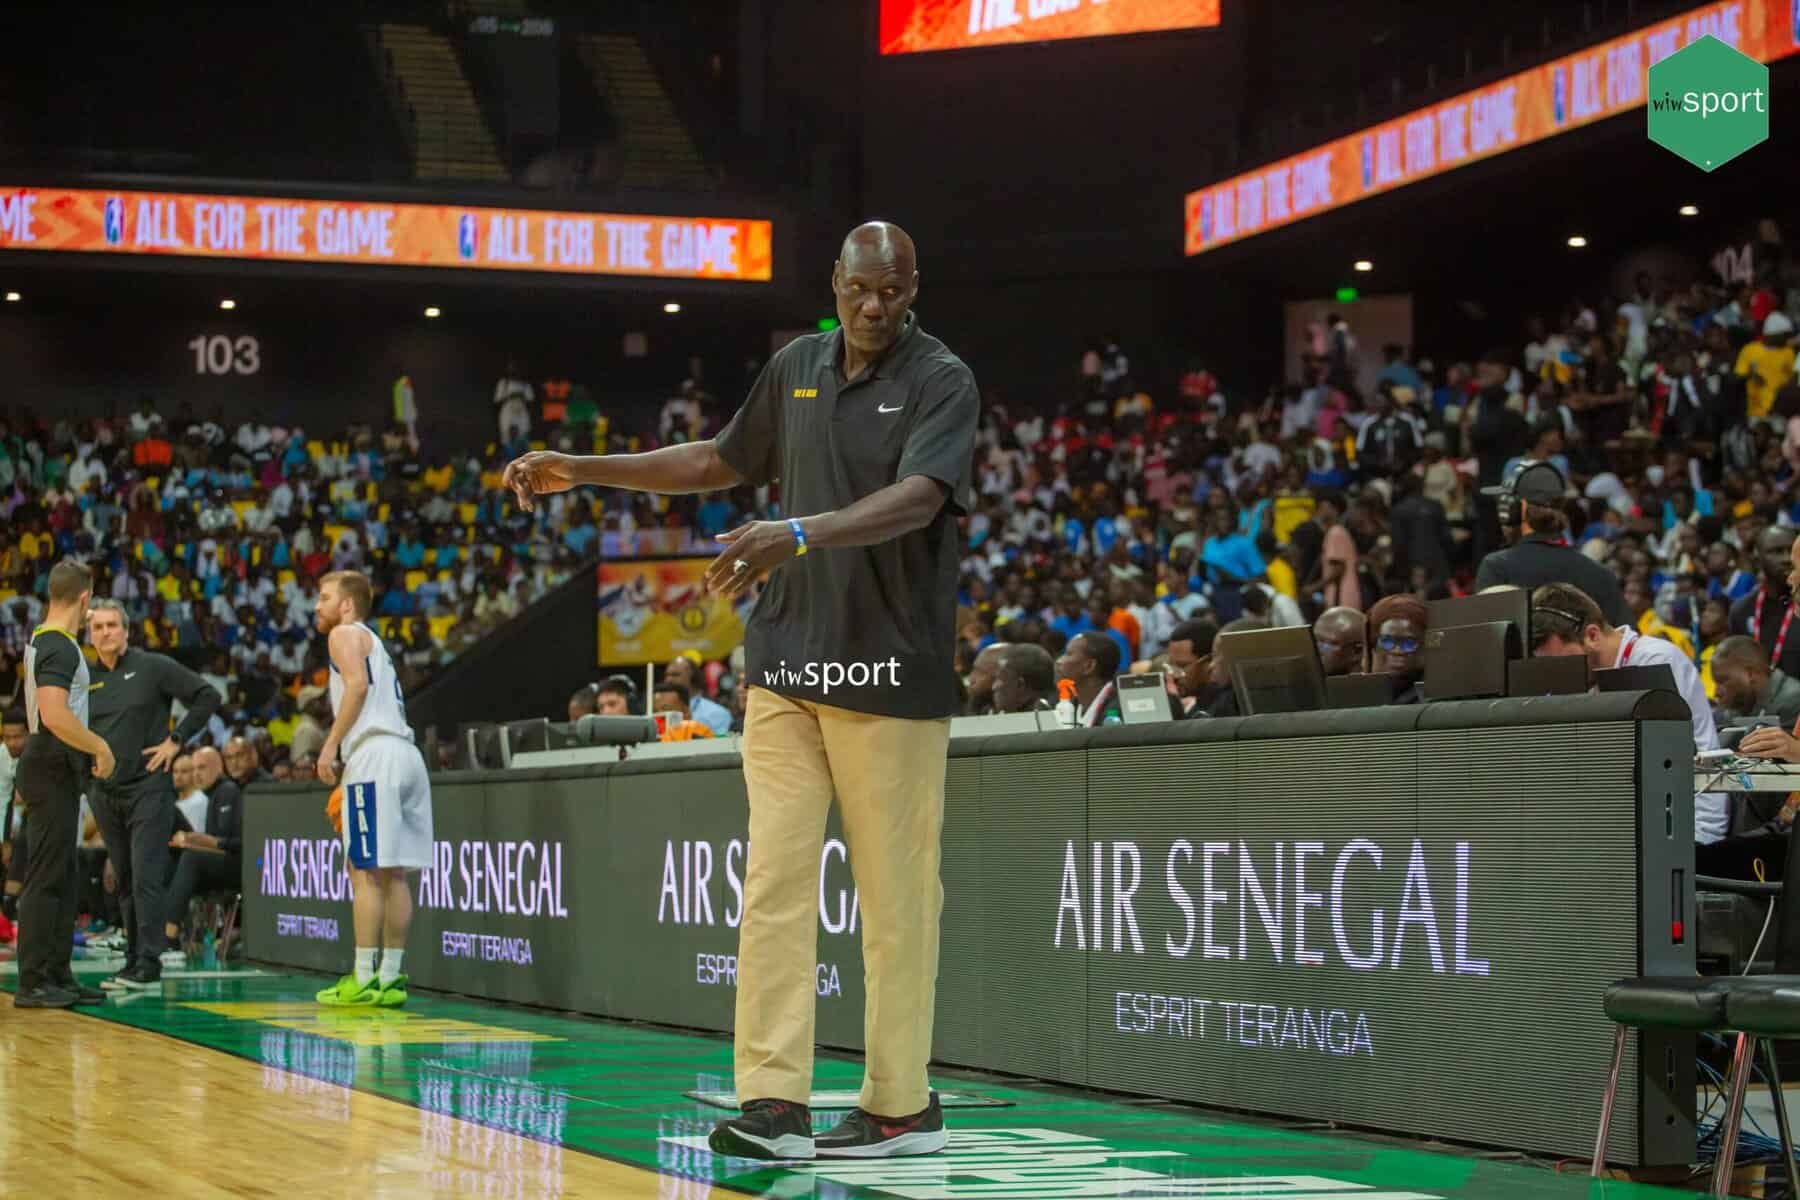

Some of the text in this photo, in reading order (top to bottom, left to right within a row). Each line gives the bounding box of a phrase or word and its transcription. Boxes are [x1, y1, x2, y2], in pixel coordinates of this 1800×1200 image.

[135, 199, 394, 257] ALL FOR THE GAME
[487, 214, 739, 273] ALL FOR THE GAME
[188, 335, 260, 375] 103
[354, 784, 372, 859] BAL
[261, 837, 354, 901] AIR SENEGA
[418, 839, 569, 920] AIR SENEGAL
[657, 839, 715, 927] AIR
[1054, 837, 1491, 977] AIR SENEGAL
[442, 930, 534, 966] ESPRIT TERANGA
[1115, 992, 1375, 1058] ESPRIT TERANGA
